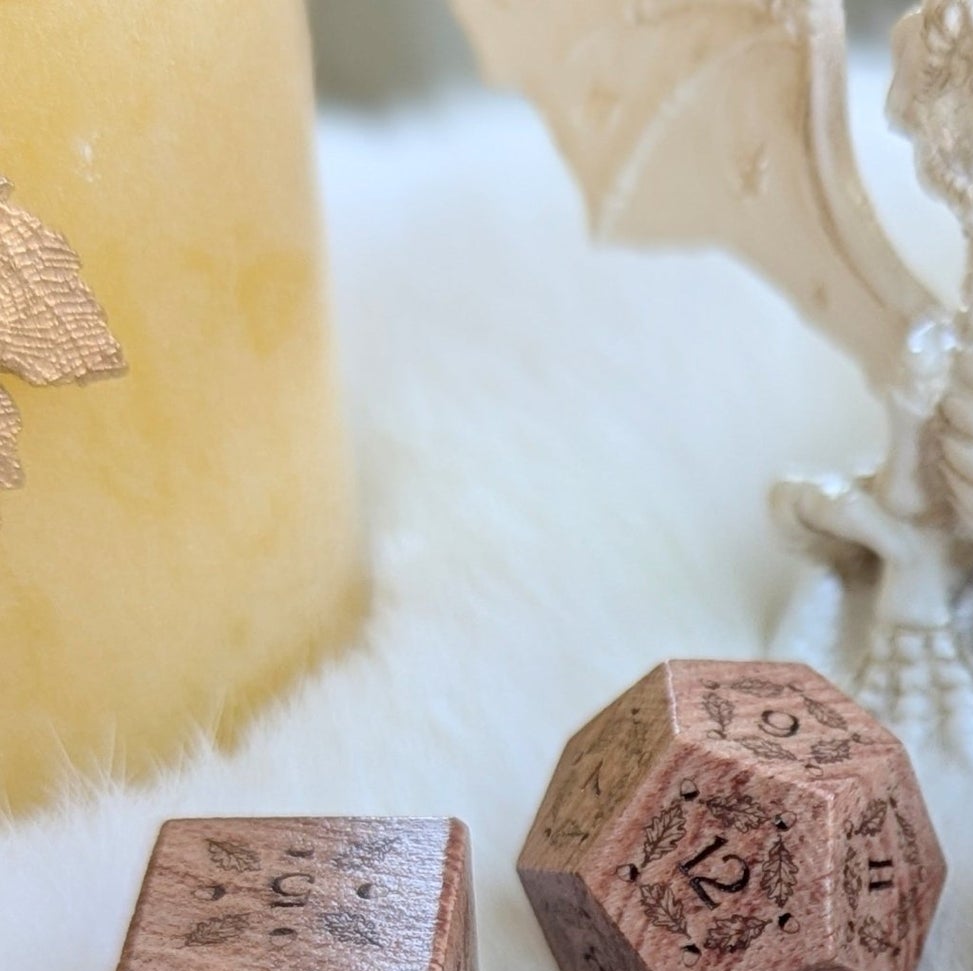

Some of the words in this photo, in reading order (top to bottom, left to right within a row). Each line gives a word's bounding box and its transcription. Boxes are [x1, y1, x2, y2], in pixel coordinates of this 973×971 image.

[269, 872, 316, 908] 5
[678, 835, 751, 911] 12
[868, 857, 895, 894] 11
